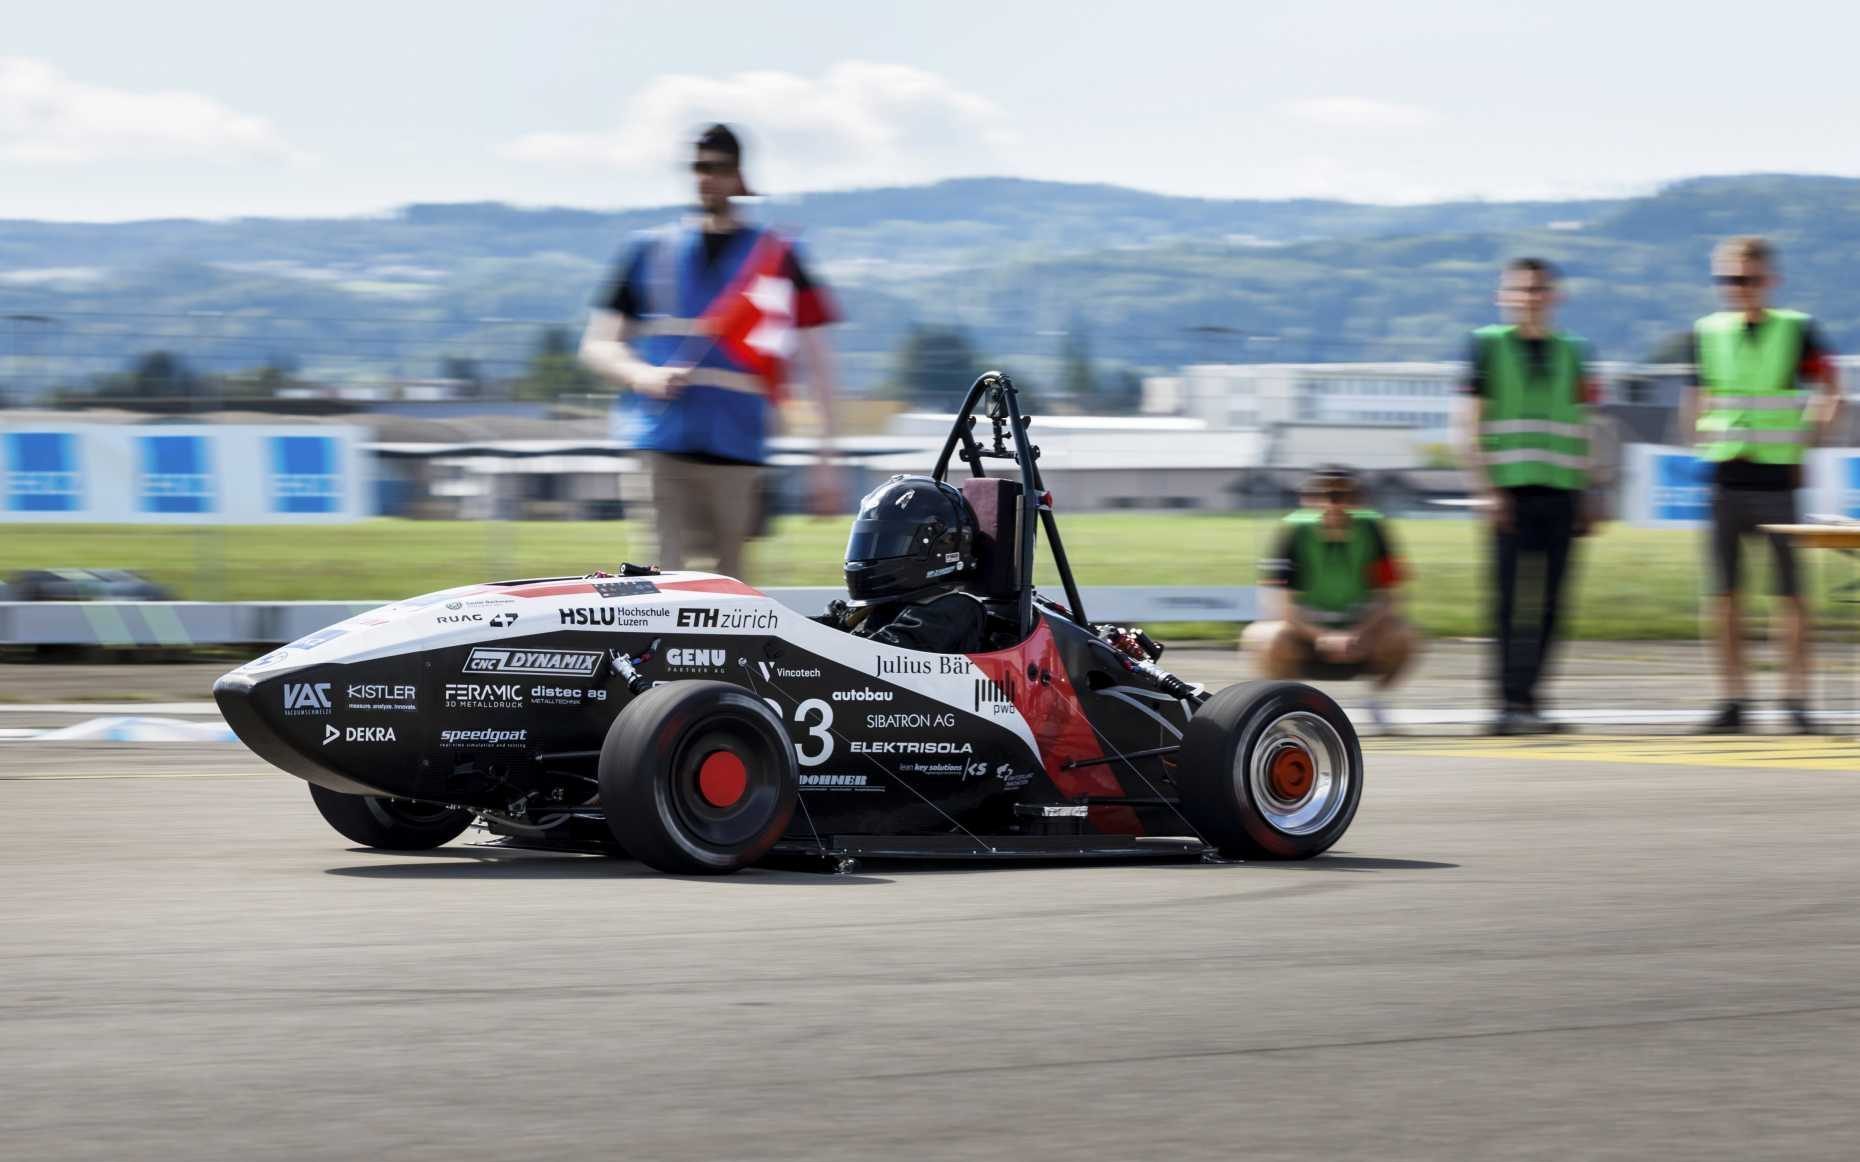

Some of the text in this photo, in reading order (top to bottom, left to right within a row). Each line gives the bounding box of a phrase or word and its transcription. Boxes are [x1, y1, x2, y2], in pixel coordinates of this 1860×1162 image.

[559, 607, 615, 626] HSLU
[618, 607, 670, 617] Hochschule
[618, 617, 649, 627] Luzern
[471, 653, 597, 670] CNC DYNAMIX
[666, 648, 726, 667] GENU
[876, 654, 974, 677] Julius Bär
[777, 668, 821, 678] Vincotech
[284, 683, 331, 709] VAC
[347, 684, 416, 699] KISTLER
[446, 684, 523, 701] FERAMIC
[531, 686, 607, 700] distec ag
[832, 687, 893, 701] autobau
[867, 713, 955, 728] SIBATRON AG
[346, 727, 396, 741] DEKRA
[441, 728, 527, 742] speedgoat
[850, 741, 973, 754] ELEKTRISOLA
